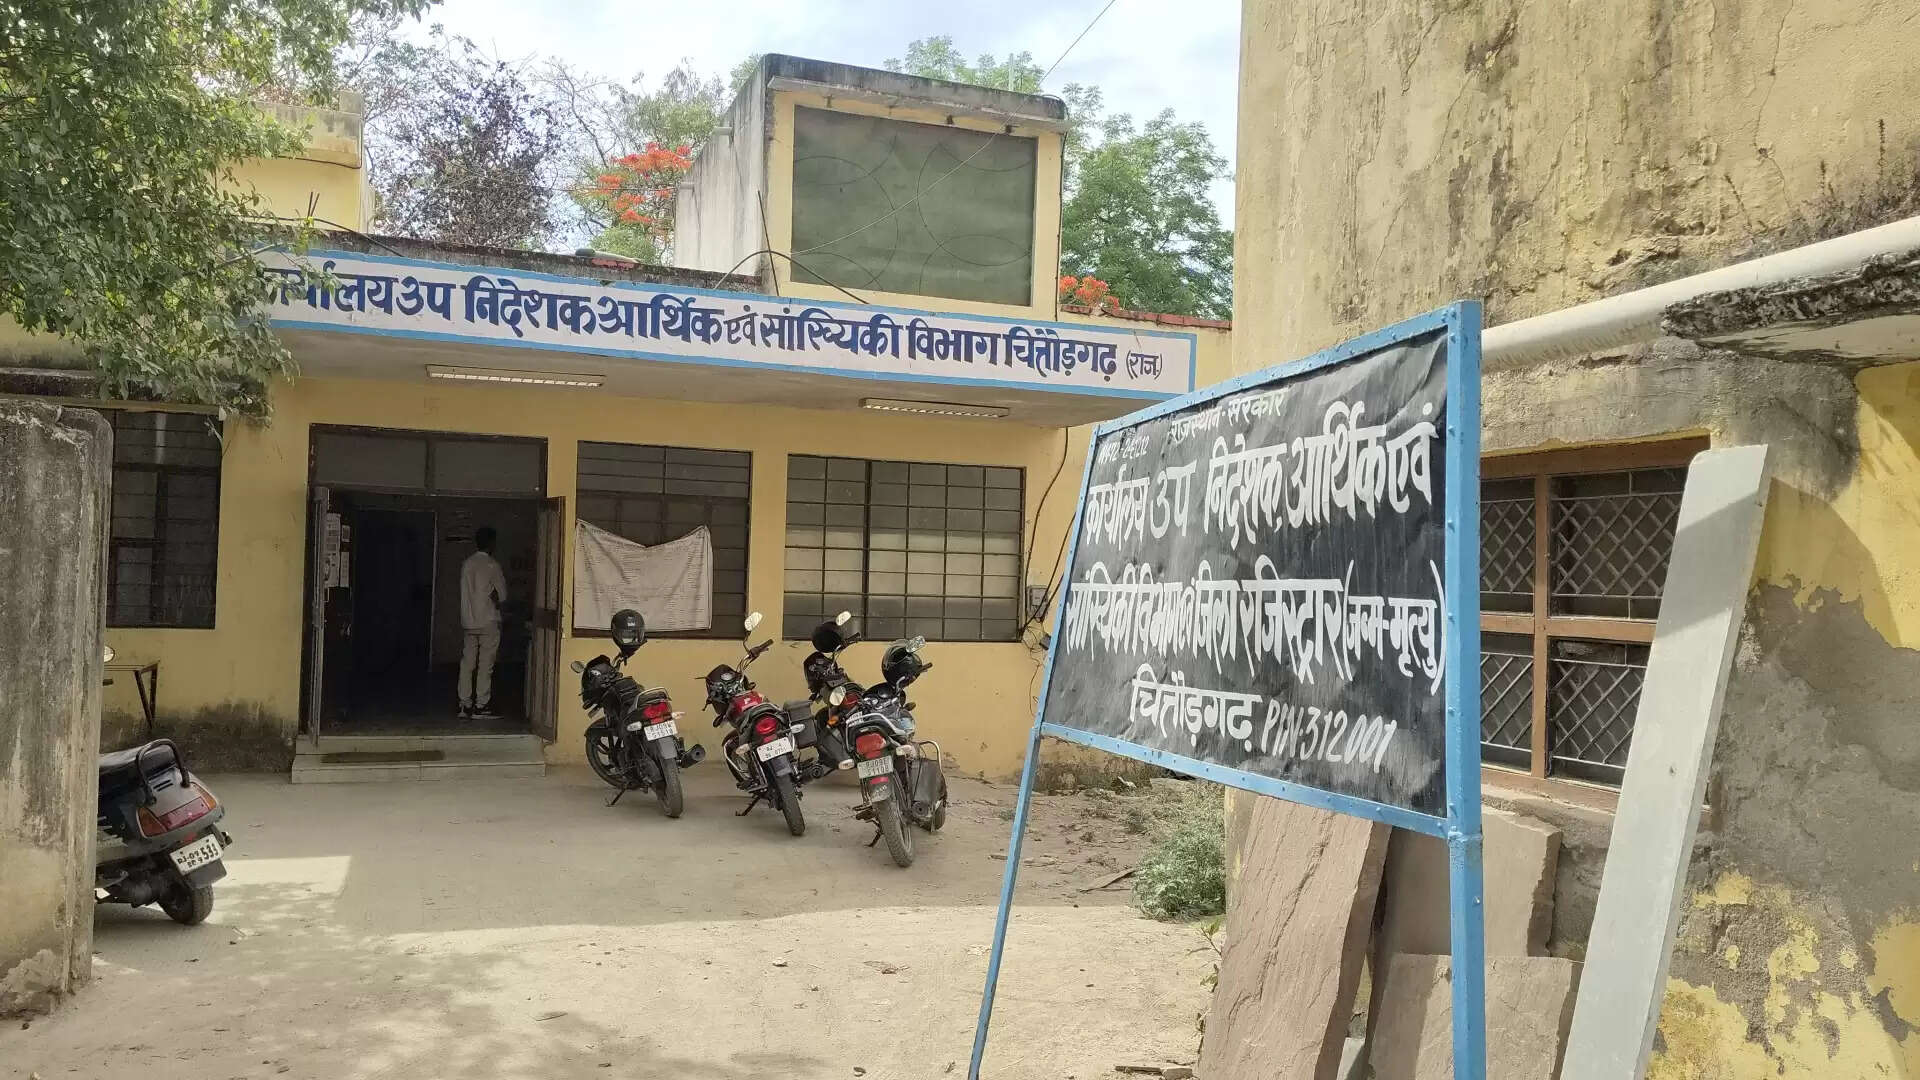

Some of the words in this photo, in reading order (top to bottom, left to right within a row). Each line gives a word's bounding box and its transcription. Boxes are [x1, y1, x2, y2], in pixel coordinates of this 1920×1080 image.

[396, 275, 456, 321] उप
[460, 275, 597, 337] निदेशक
[597, 294, 724, 345] आर्थिक
[724, 305, 758, 347] एवं
[760, 305, 903, 359] सांख्यिकी
[906, 318, 1001, 366] विभाग
[1086, 464, 1150, 551] कार्यालय
[1150, 459, 1197, 539] उप
[1285, 400, 1387, 529] आर्थिक
[1386, 402, 1439, 514] एवं
[1193, 559, 1240, 675] जिला
[1239, 554, 1344, 685] रजिस्ट्रार
